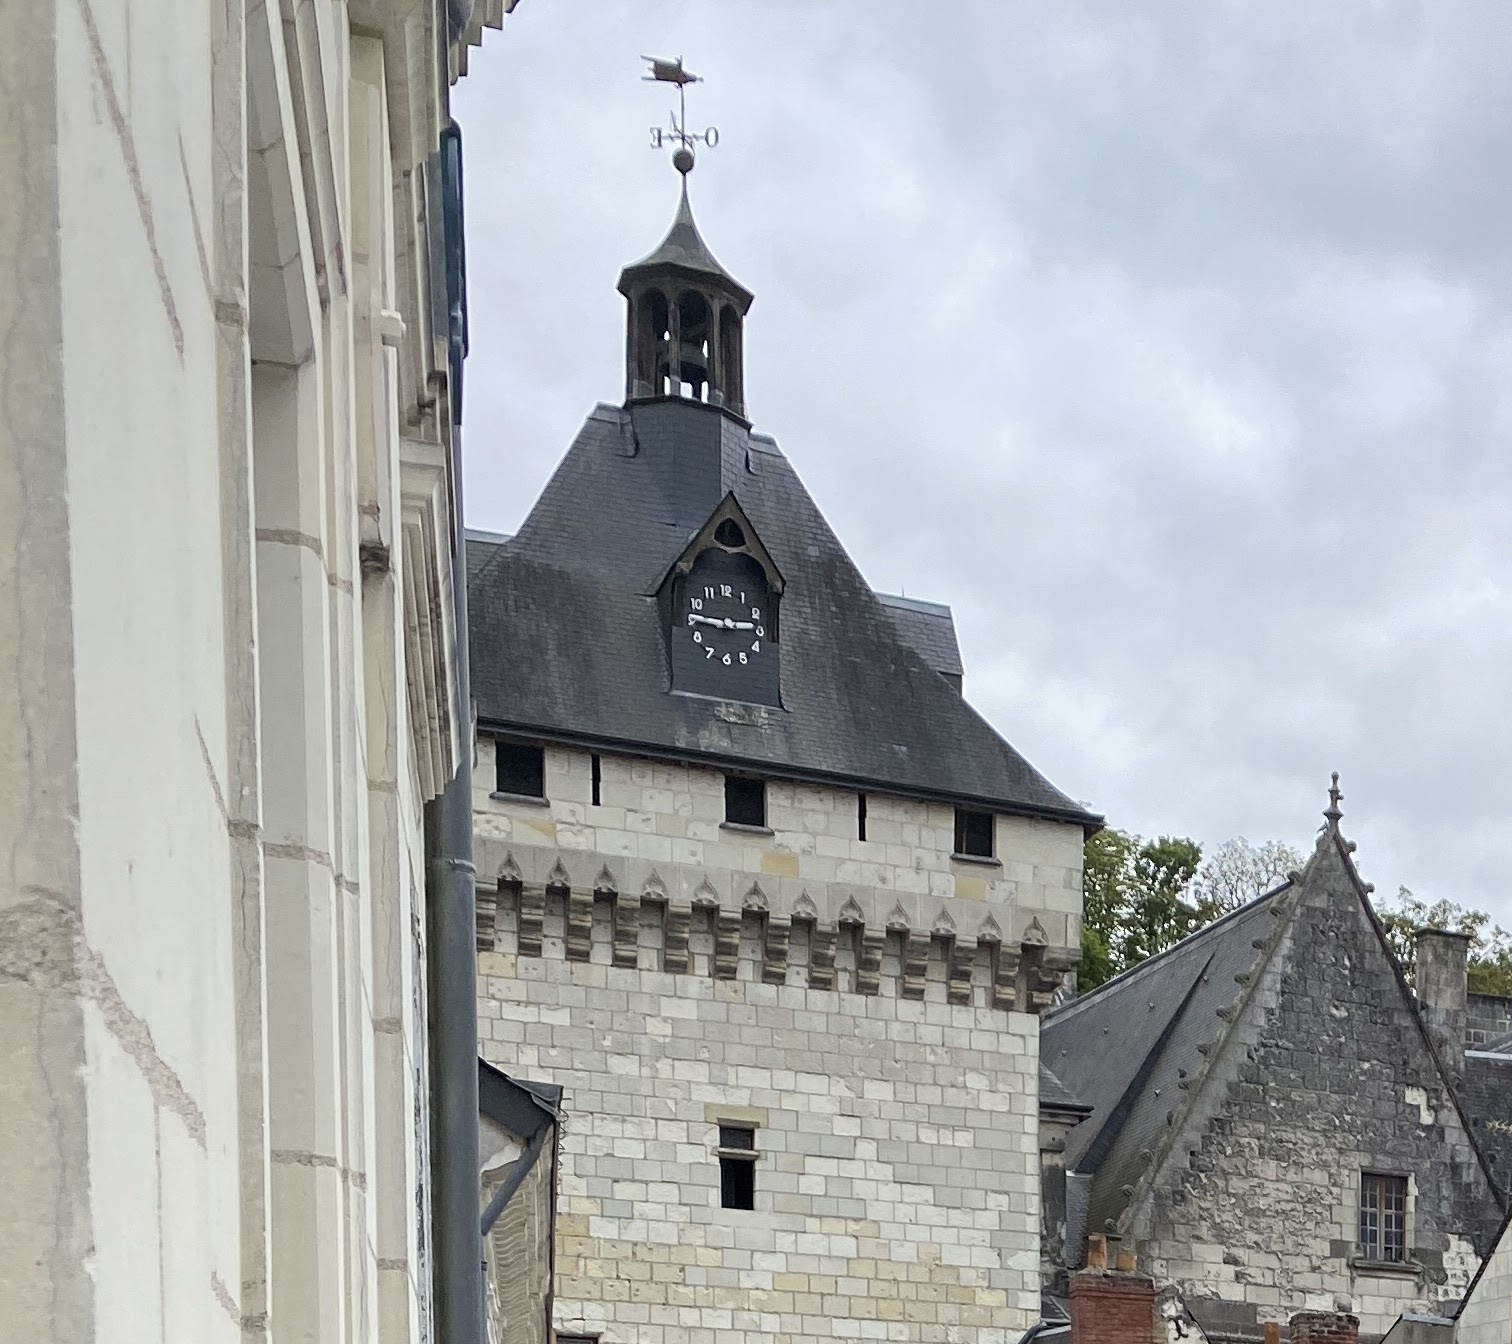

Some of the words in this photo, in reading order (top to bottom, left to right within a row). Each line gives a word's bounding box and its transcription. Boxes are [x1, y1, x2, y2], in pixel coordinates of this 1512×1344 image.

[704, 586, 714, 599] 11
[720, 584, 732, 597] 12
[690, 598, 702, 610] 10
[740, 592, 745, 604] 1
[693, 631, 702, 643] 8
[752, 641, 760, 652] 4
[705, 647, 714, 659] 7
[739, 652, 748, 664] 5
[722, 654, 731, 665] 6
